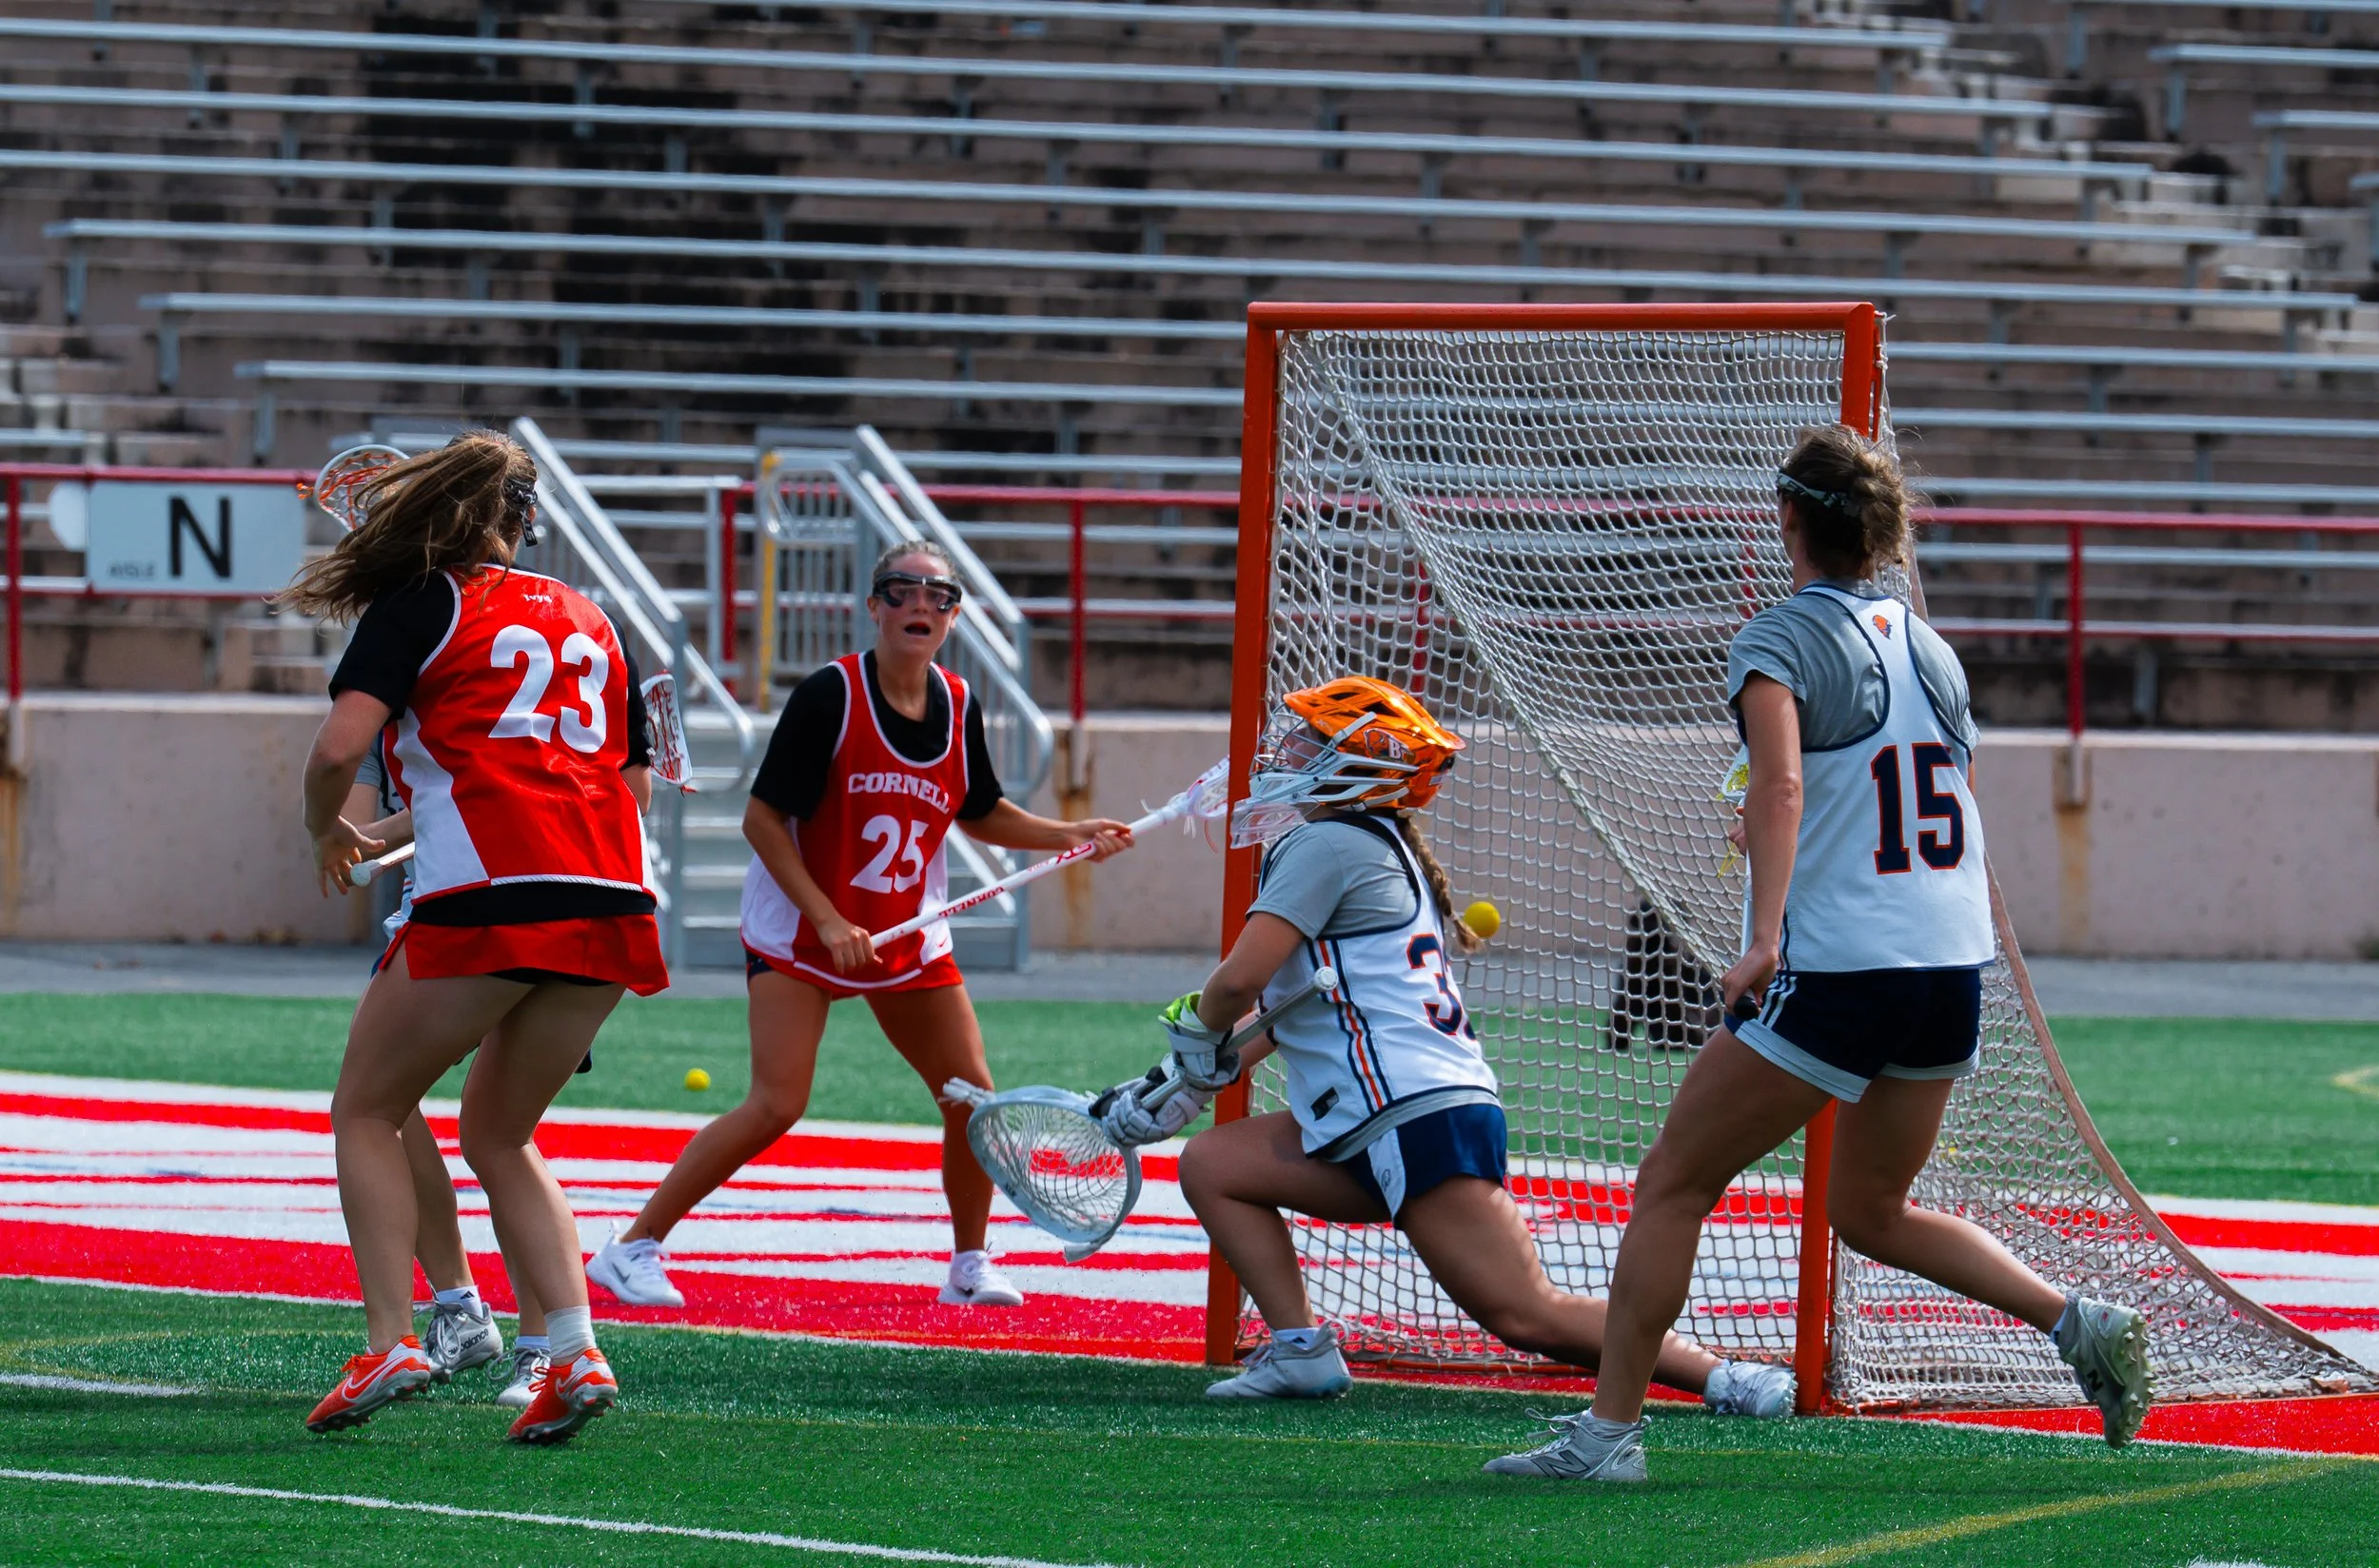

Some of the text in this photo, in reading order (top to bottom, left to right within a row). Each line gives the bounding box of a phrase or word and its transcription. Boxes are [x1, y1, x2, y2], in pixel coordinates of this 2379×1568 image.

[169, 497, 231, 578] N
[488, 624, 609, 753] 23
[848, 773, 950, 814] CORNELL
[1870, 742, 1965, 875] 15
[850, 814, 929, 893] 25
[461, 1329, 488, 1352] balance
